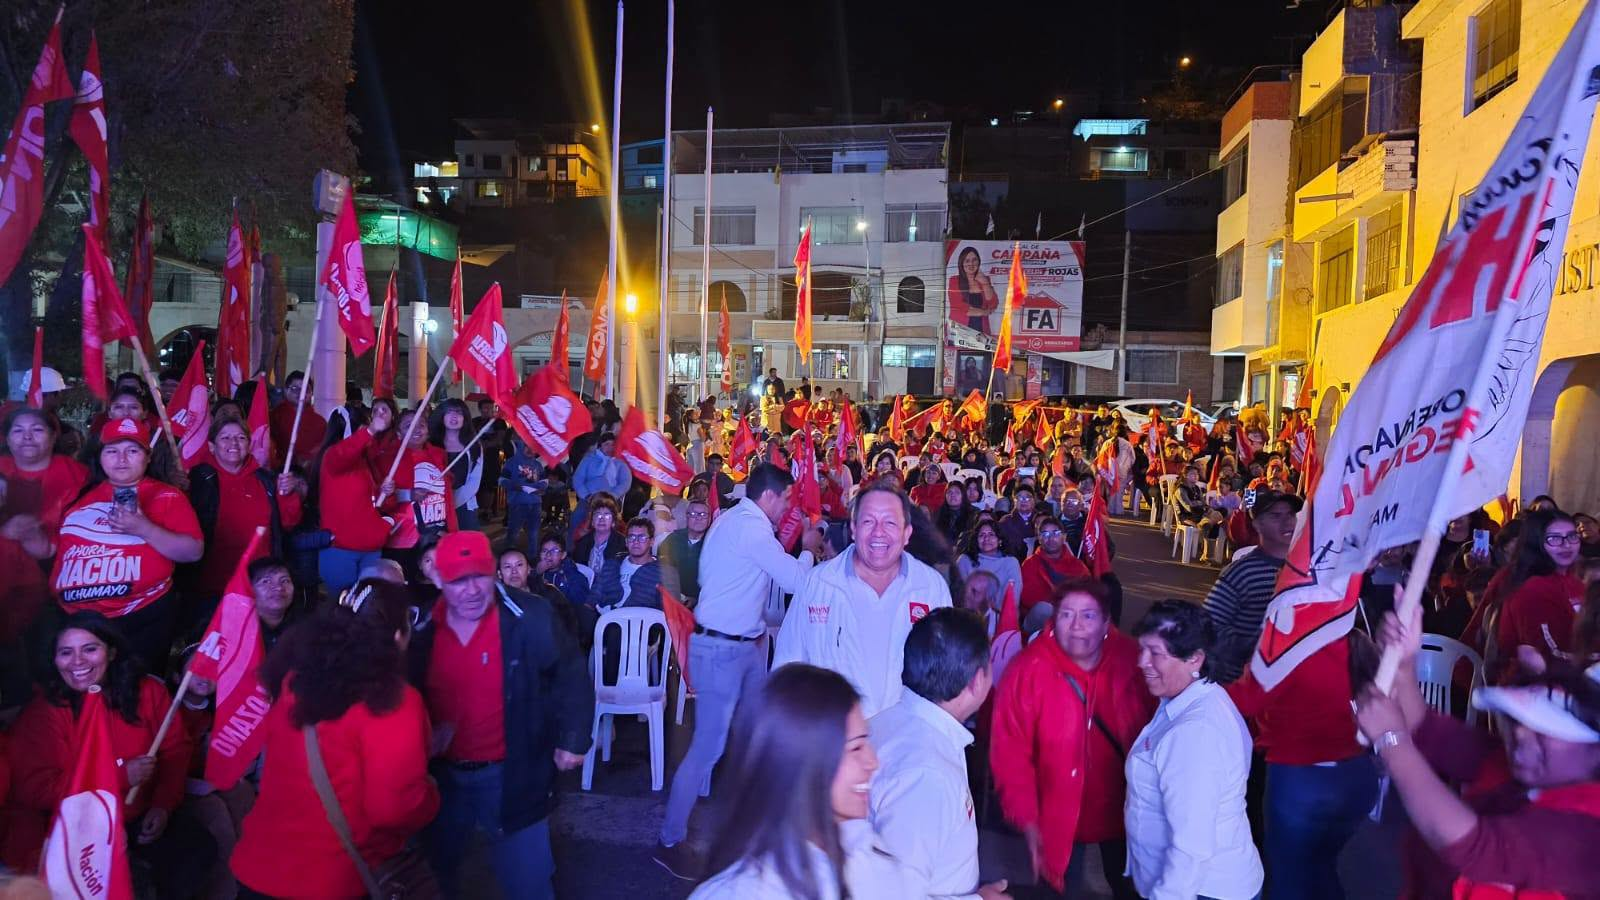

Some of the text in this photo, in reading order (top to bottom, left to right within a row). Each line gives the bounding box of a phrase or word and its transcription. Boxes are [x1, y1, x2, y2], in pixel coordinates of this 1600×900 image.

[992, 248, 1060, 260] CAPAÑA
[1048, 267, 1079, 276] ROJAS
[1026, 309, 1055, 330] FA
[56, 550, 142, 590] NACIÓN
[64, 584, 128, 601] UCHUMAYO
[80, 843, 104, 897] Nación
